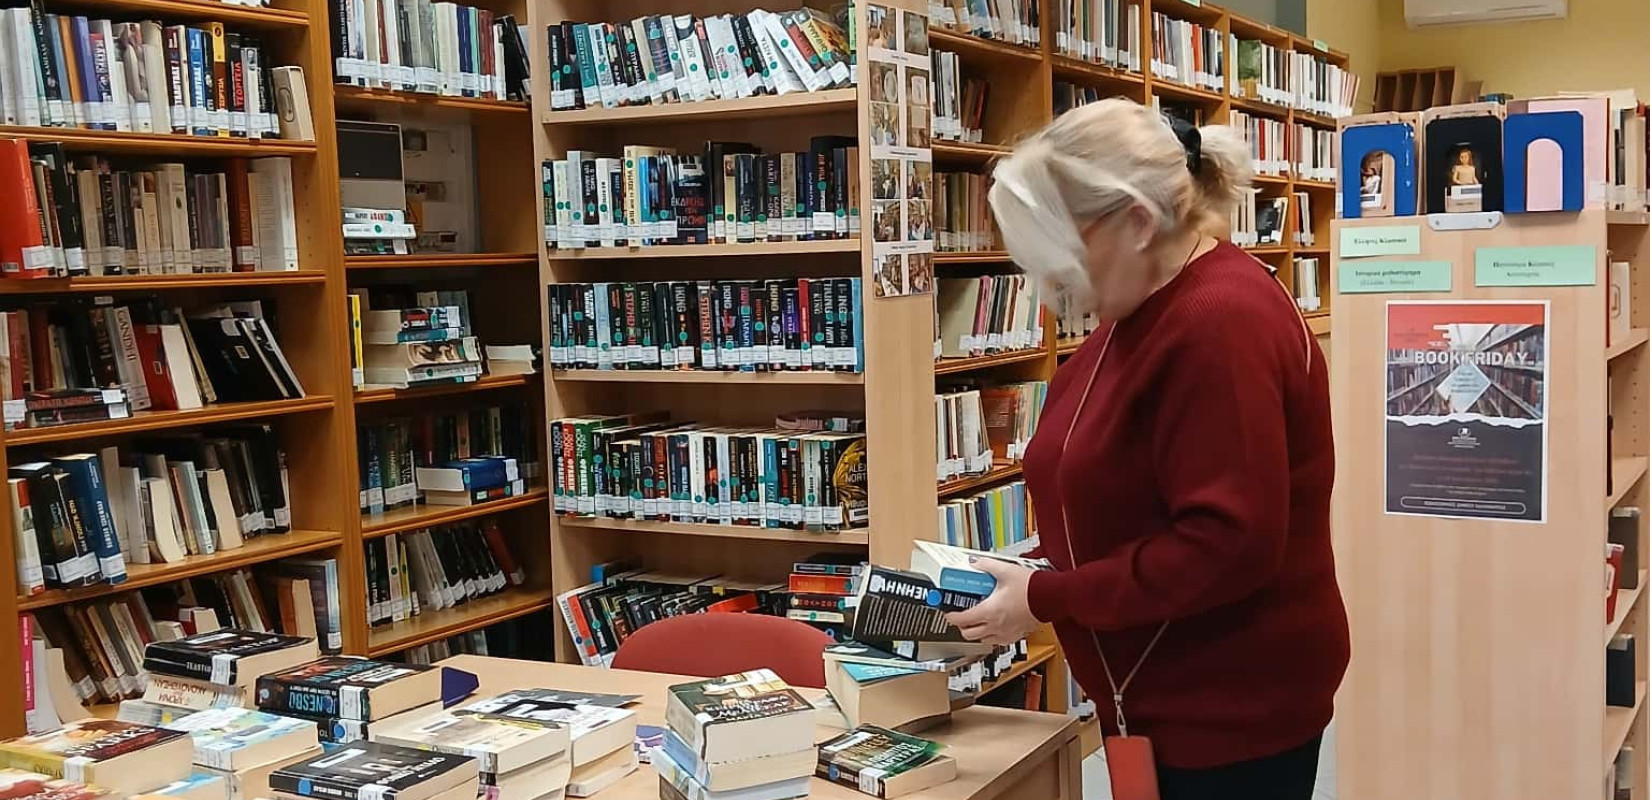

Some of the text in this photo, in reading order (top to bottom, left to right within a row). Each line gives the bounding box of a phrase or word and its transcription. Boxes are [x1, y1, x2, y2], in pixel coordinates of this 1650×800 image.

[117, 310, 138, 363] GANDHI
[1414, 350, 1529, 367] BOOK FRIDAY
